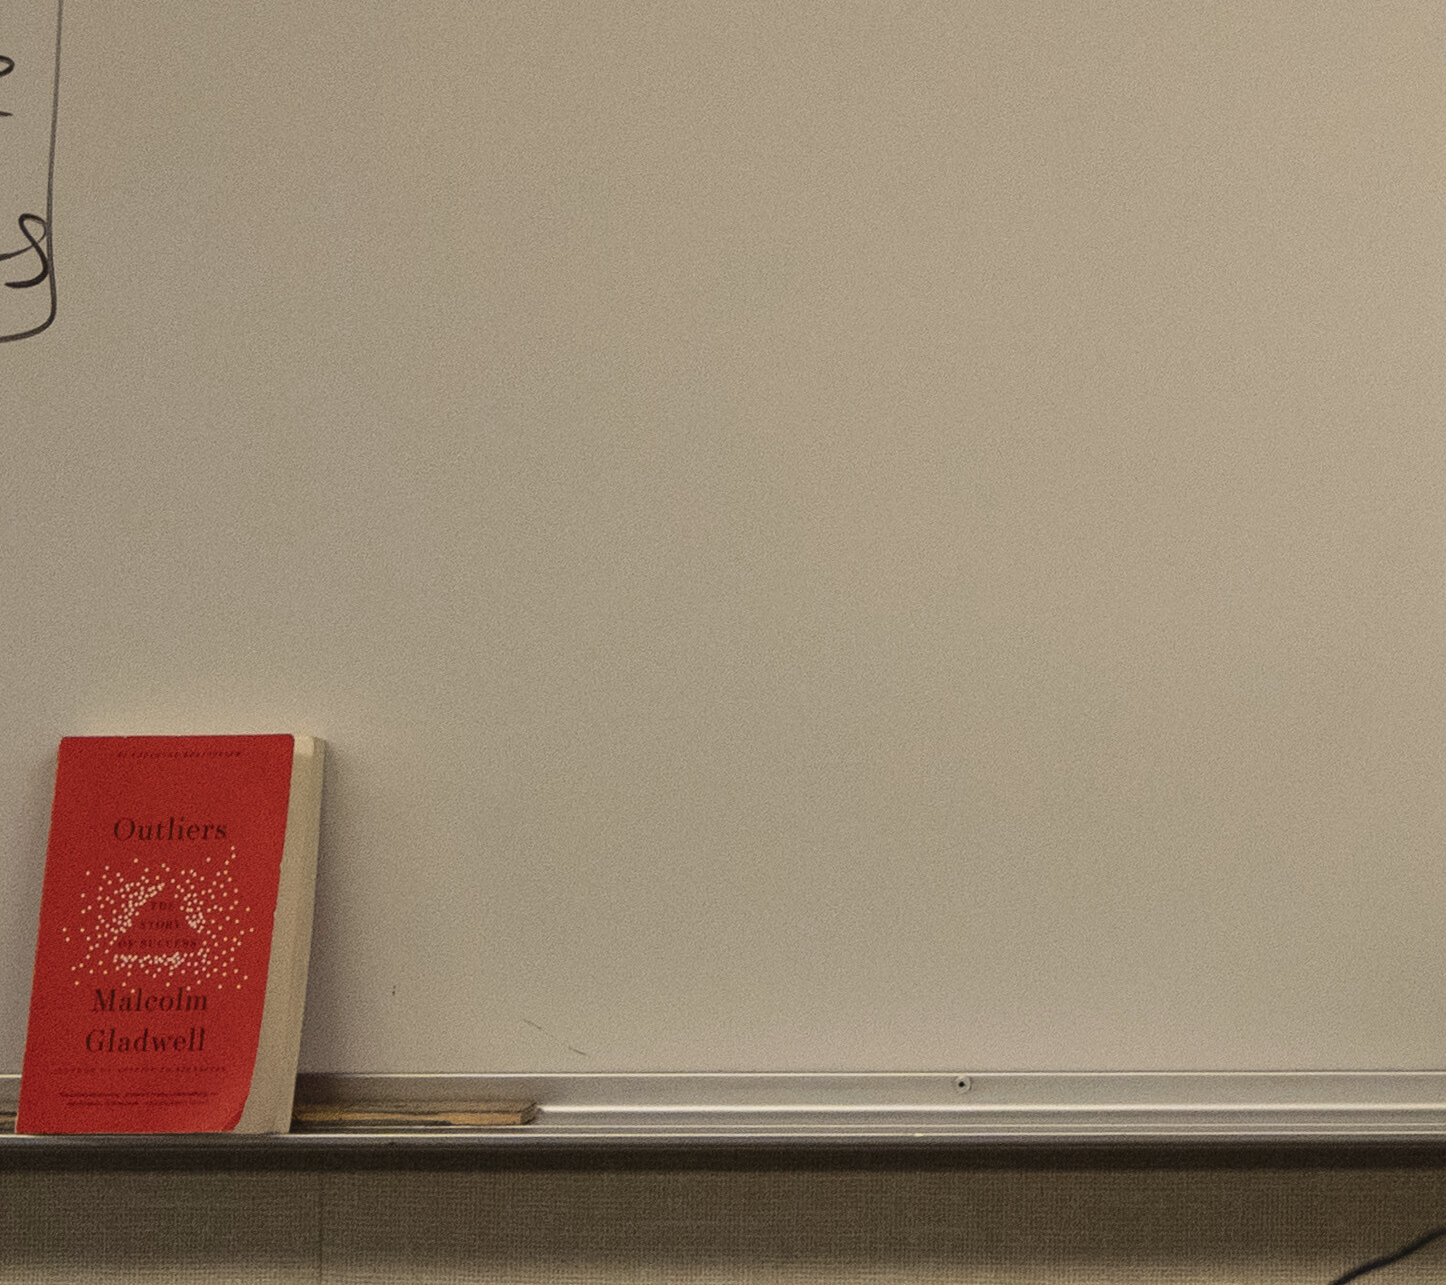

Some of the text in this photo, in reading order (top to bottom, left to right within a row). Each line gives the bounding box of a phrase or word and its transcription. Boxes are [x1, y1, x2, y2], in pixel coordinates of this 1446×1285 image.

[113, 816, 228, 843] Outliers
[90, 987, 208, 1016] Malcolm
[84, 1027, 206, 1054] Gladwell
